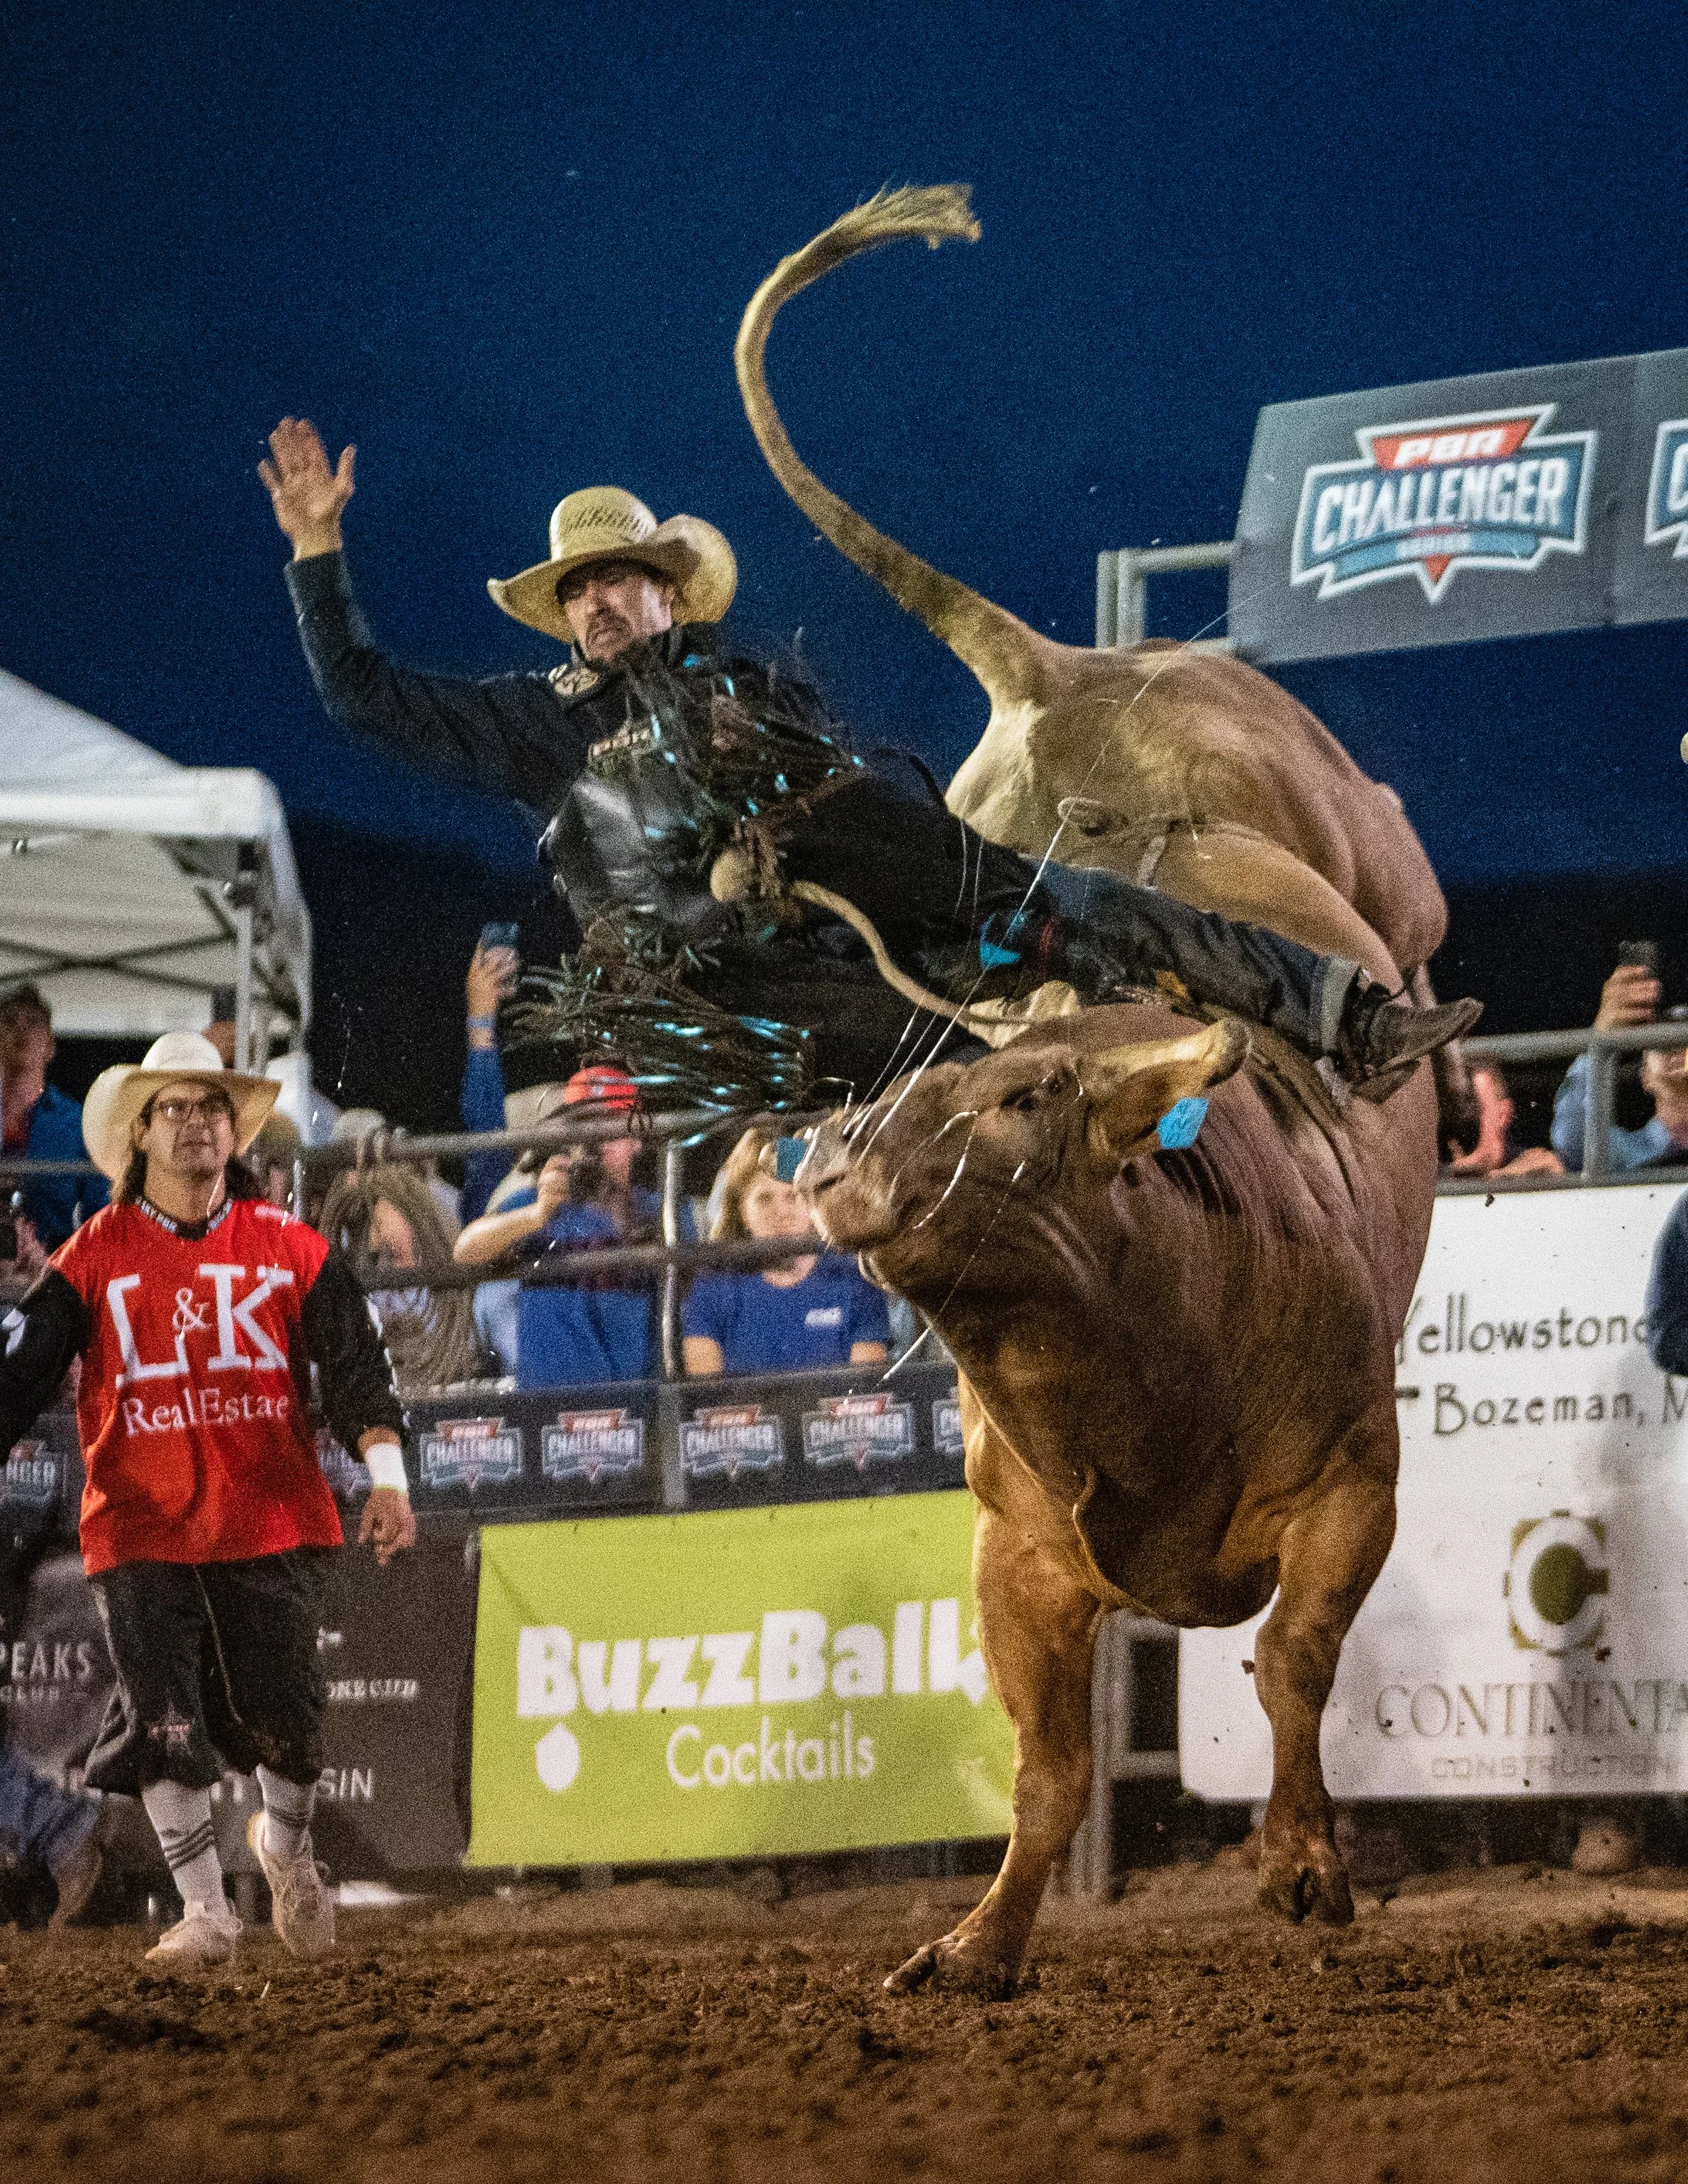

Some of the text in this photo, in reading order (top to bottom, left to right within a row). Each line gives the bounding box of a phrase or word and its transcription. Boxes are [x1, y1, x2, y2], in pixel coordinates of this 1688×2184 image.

[1312, 457, 1570, 555] CHALLENGER
[199, 1386, 290, 1425] Estae
[1433, 1382, 1645, 1437] Bozeman,
[665, 1710, 876, 1789] Cocktails
[317, 1767, 374, 1801] SIN
